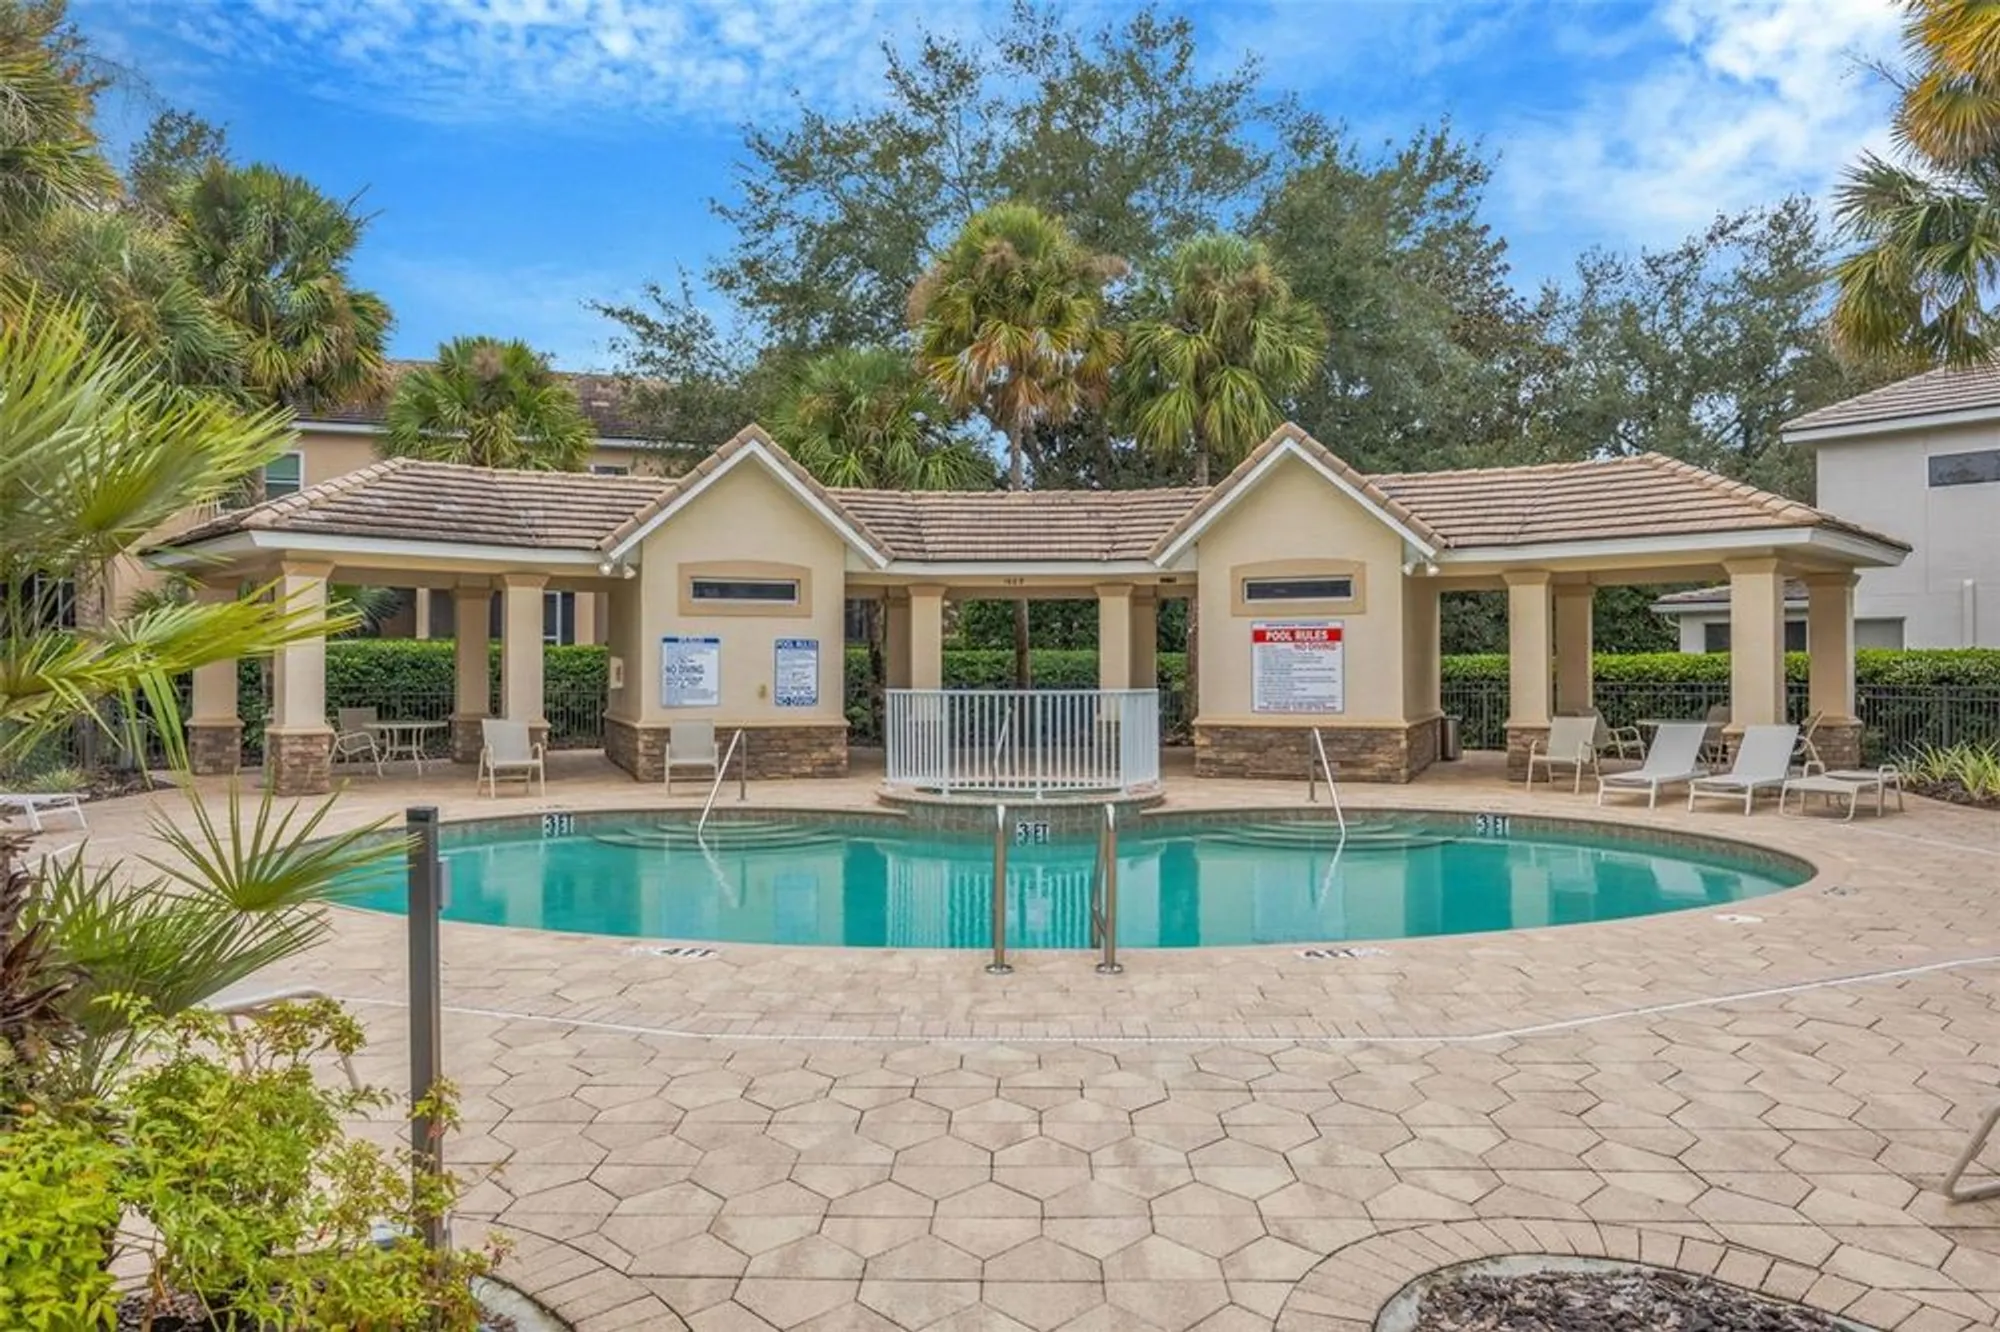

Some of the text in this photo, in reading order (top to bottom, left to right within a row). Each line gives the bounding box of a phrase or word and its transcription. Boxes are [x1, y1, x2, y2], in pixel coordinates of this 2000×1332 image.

[1265, 629, 1328, 641] POOL RULES
[1294, 643, 1306, 651] NO
